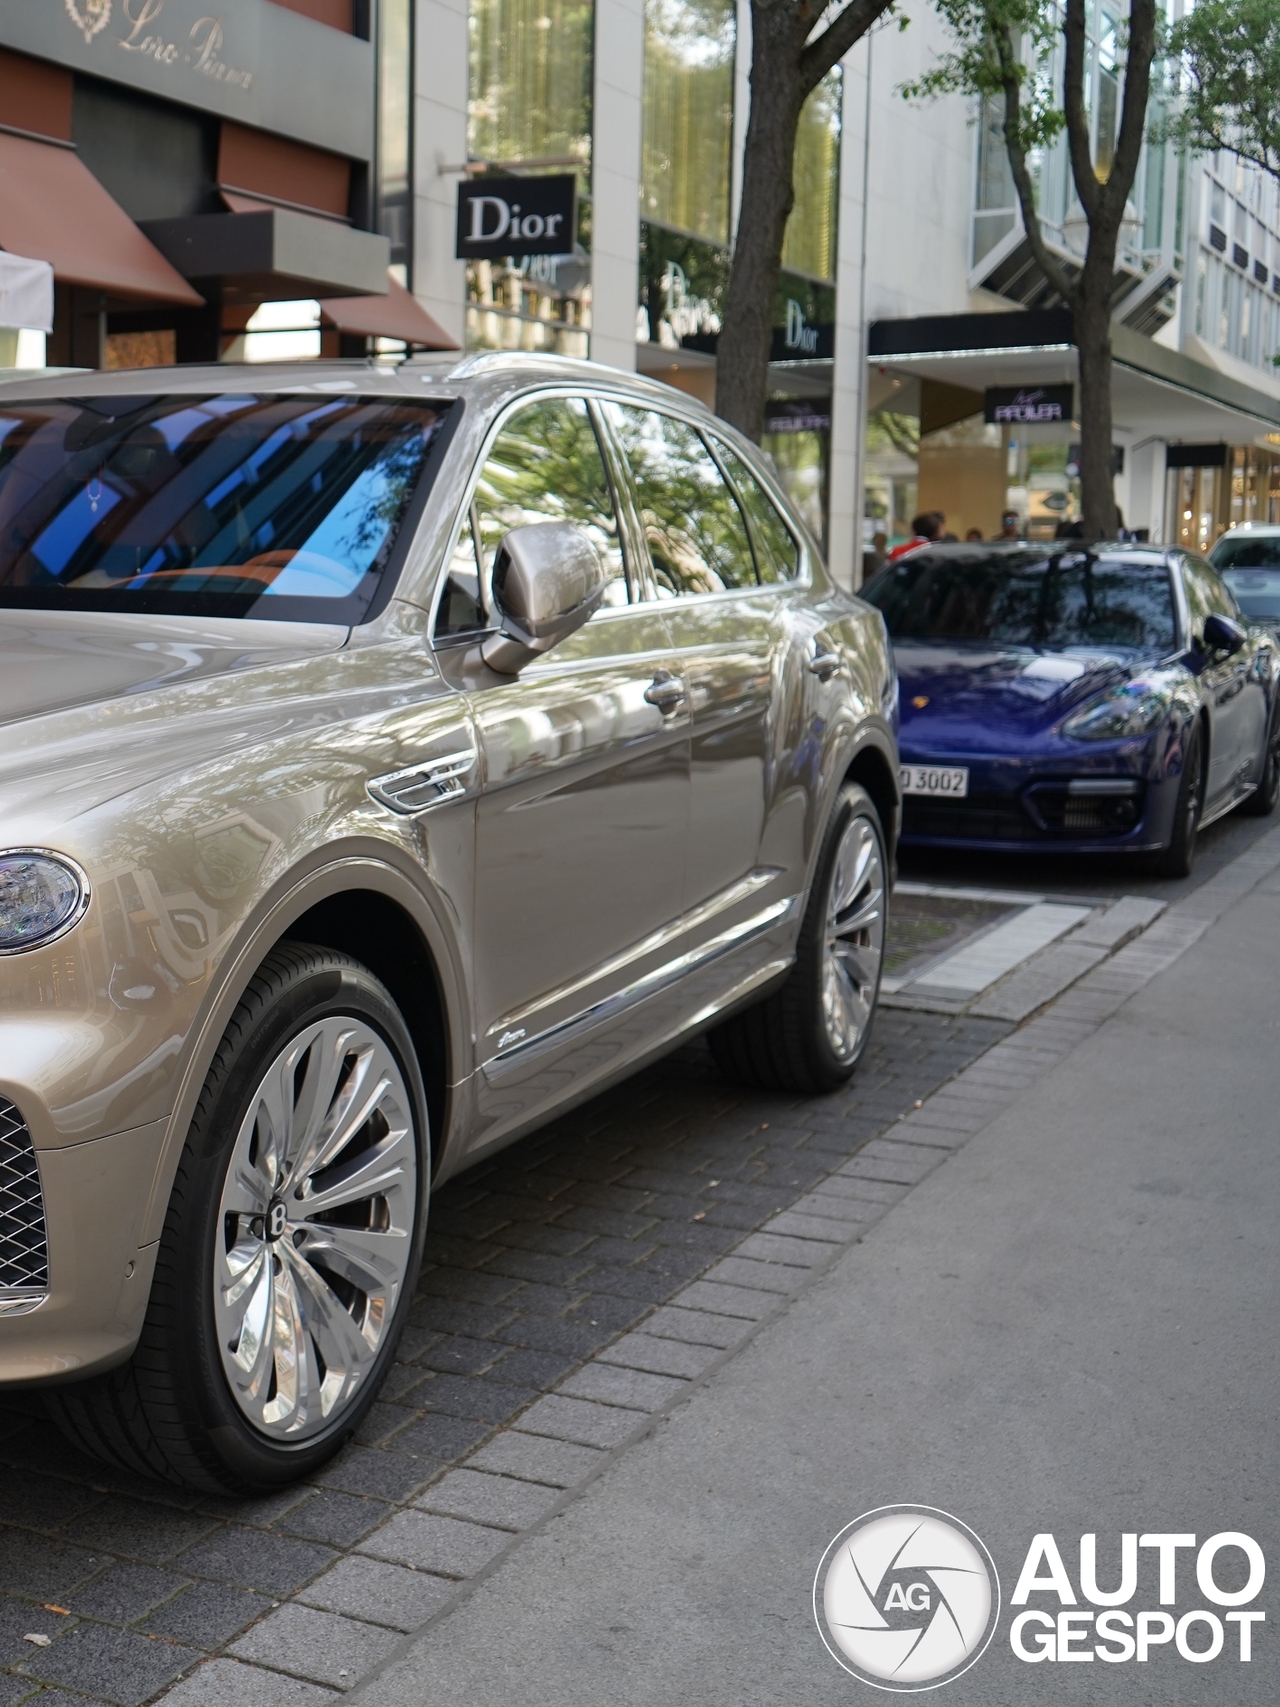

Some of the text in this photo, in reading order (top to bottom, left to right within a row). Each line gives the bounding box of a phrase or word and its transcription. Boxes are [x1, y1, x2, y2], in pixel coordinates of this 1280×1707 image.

[464, 196, 563, 242] Dior
[786, 298, 818, 353] Dior
[916, 770, 964, 791] 3002
